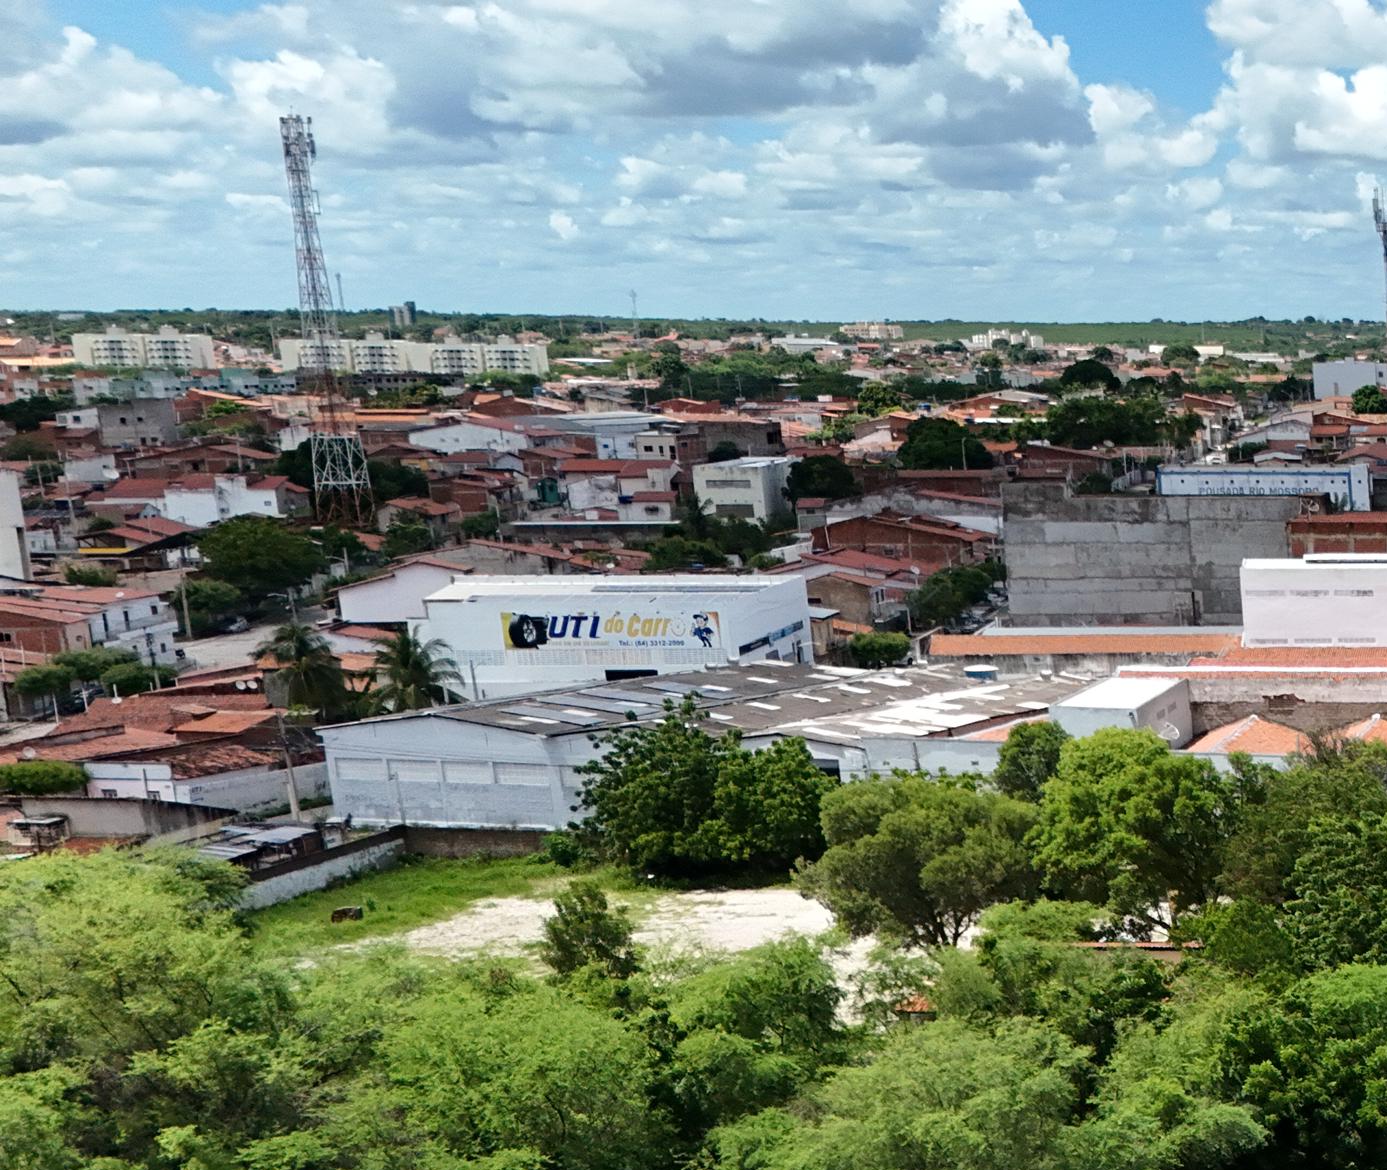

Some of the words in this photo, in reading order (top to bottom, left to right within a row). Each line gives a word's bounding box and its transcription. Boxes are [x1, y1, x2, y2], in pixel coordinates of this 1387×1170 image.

[1200, 487, 1244, 495] POUSADA
[550, 615, 600, 638] UTI
[603, 616, 624, 634] do
